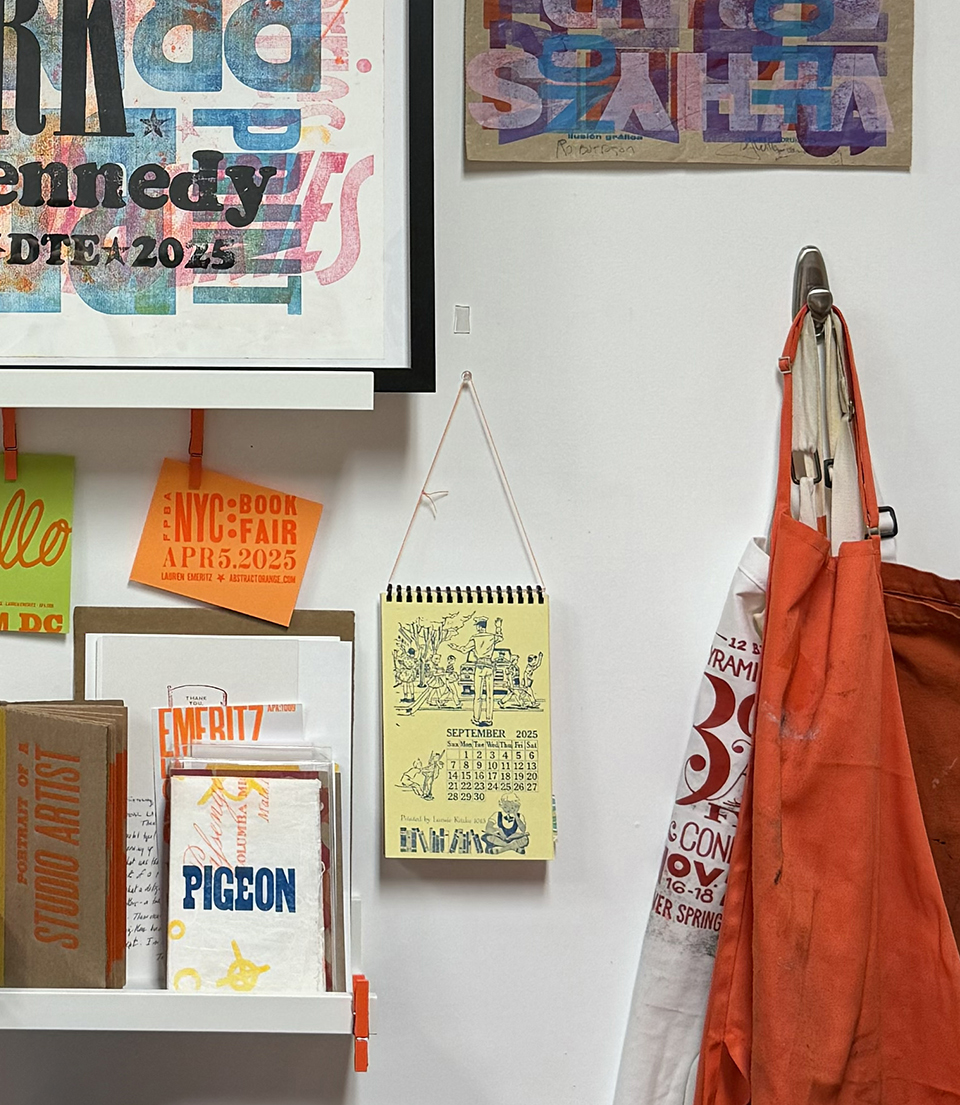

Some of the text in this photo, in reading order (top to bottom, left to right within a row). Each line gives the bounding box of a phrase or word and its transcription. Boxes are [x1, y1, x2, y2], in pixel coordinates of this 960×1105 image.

[174, 491, 297, 543] NYC BOOK
[240, 518, 297, 545] FAIR
[161, 572, 185, 581] LAUREN
[187, 572, 213, 582] EMERITZ
[19, 612, 63, 633] DC
[446, 729, 538, 738] SEPTEMBER 2025
[464, 751, 468, 759] 1
[477, 751, 482, 759] 2
[490, 751, 495, 759] 3
[502, 751, 508, 759] 4
[464, 761, 469, 769] 8
[514, 762, 524, 770] 12
[527, 762, 537, 770] 13
[448, 782, 457, 790] 21
[461, 782, 471, 790] 22
[474, 782, 485, 790] 23
[501, 783, 511, 791] 25
[514, 783, 524, 791] 26
[527, 783, 537, 791] 27
[475, 772, 484, 780] 16
[488, 772, 497, 780] 17
[16, 742, 29, 885] PORTRAIT OF A
[34, 742, 80, 950] STUDIO ARTIST
[680, 821, 734, 864] CON
[183, 864, 297, 913] PIGEON
[666, 877, 714, 903] 16-18
